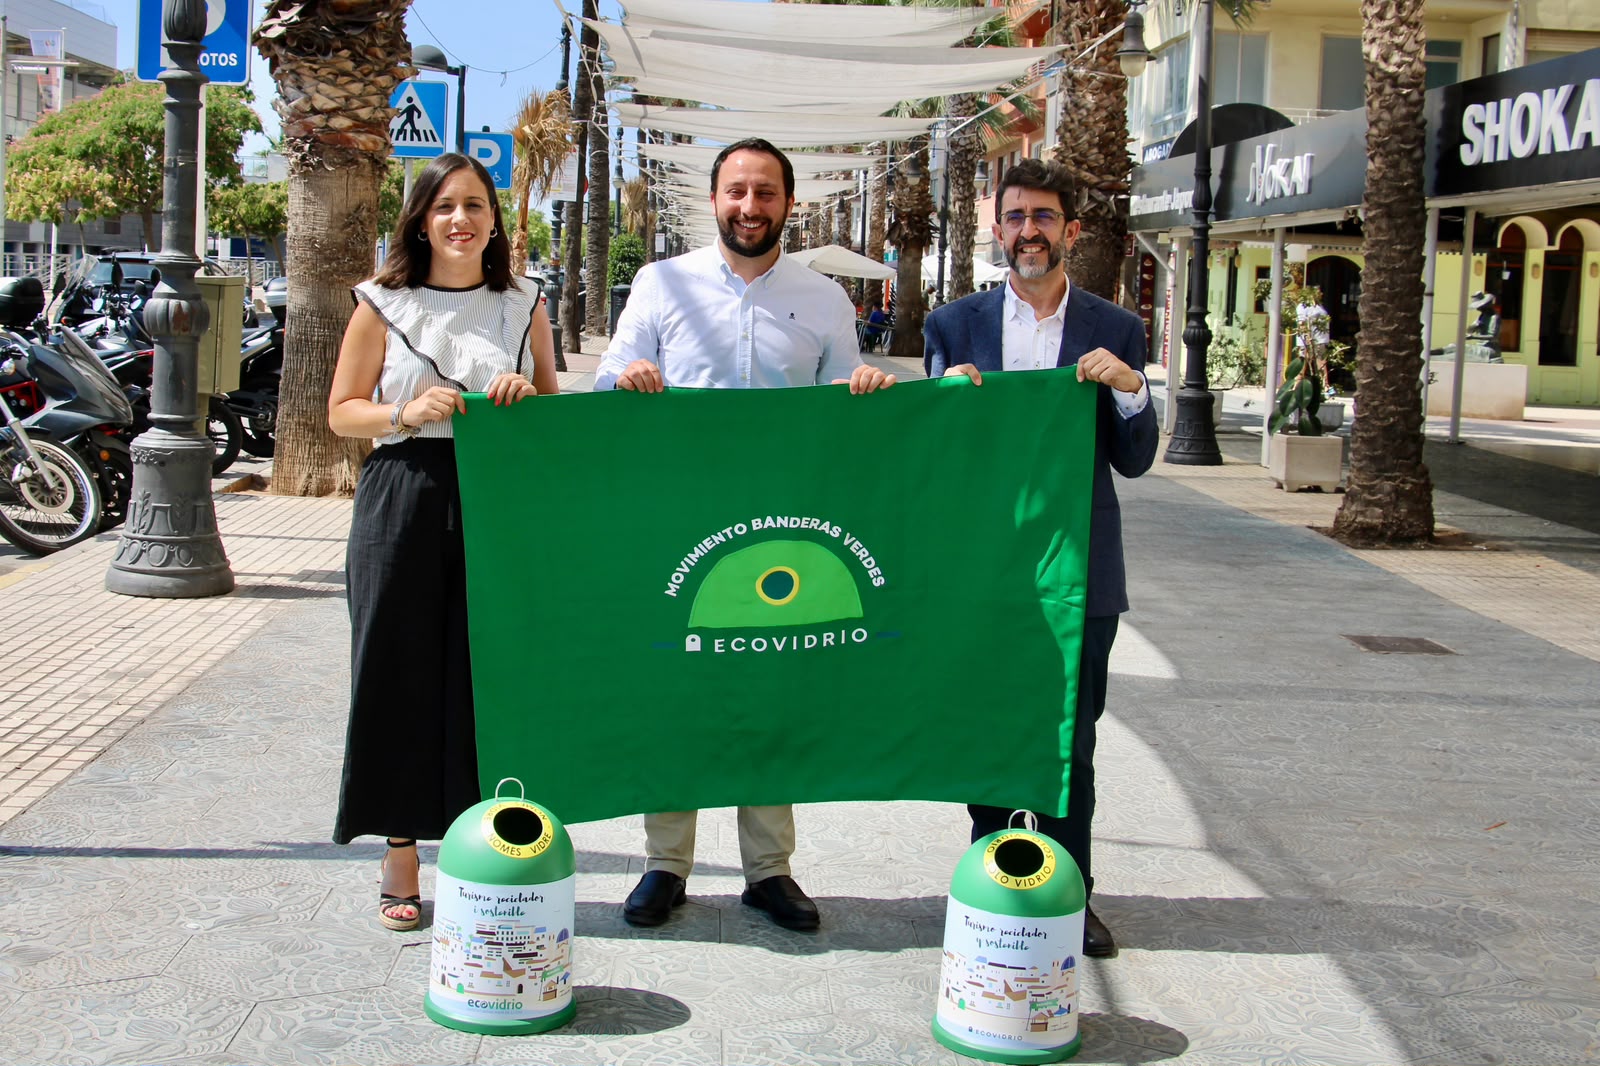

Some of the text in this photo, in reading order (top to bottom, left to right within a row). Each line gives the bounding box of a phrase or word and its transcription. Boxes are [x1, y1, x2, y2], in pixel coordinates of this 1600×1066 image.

[196, 52, 238, 67] OTOS
[1460, 78, 1600, 167] SHOKA
[468, 138, 502, 168] P
[664, 515, 885, 597] MOVIMIENTO BANDERAS VERDES
[714, 627, 868, 653] ECOVIDRIO
[530, 832, 552, 855] VIDRE
[1015, 866, 1051, 888] VIDRIO
[467, 998, 523, 1010] ecovidrio
[975, 1029, 1023, 1041] ECOVIDRIO
